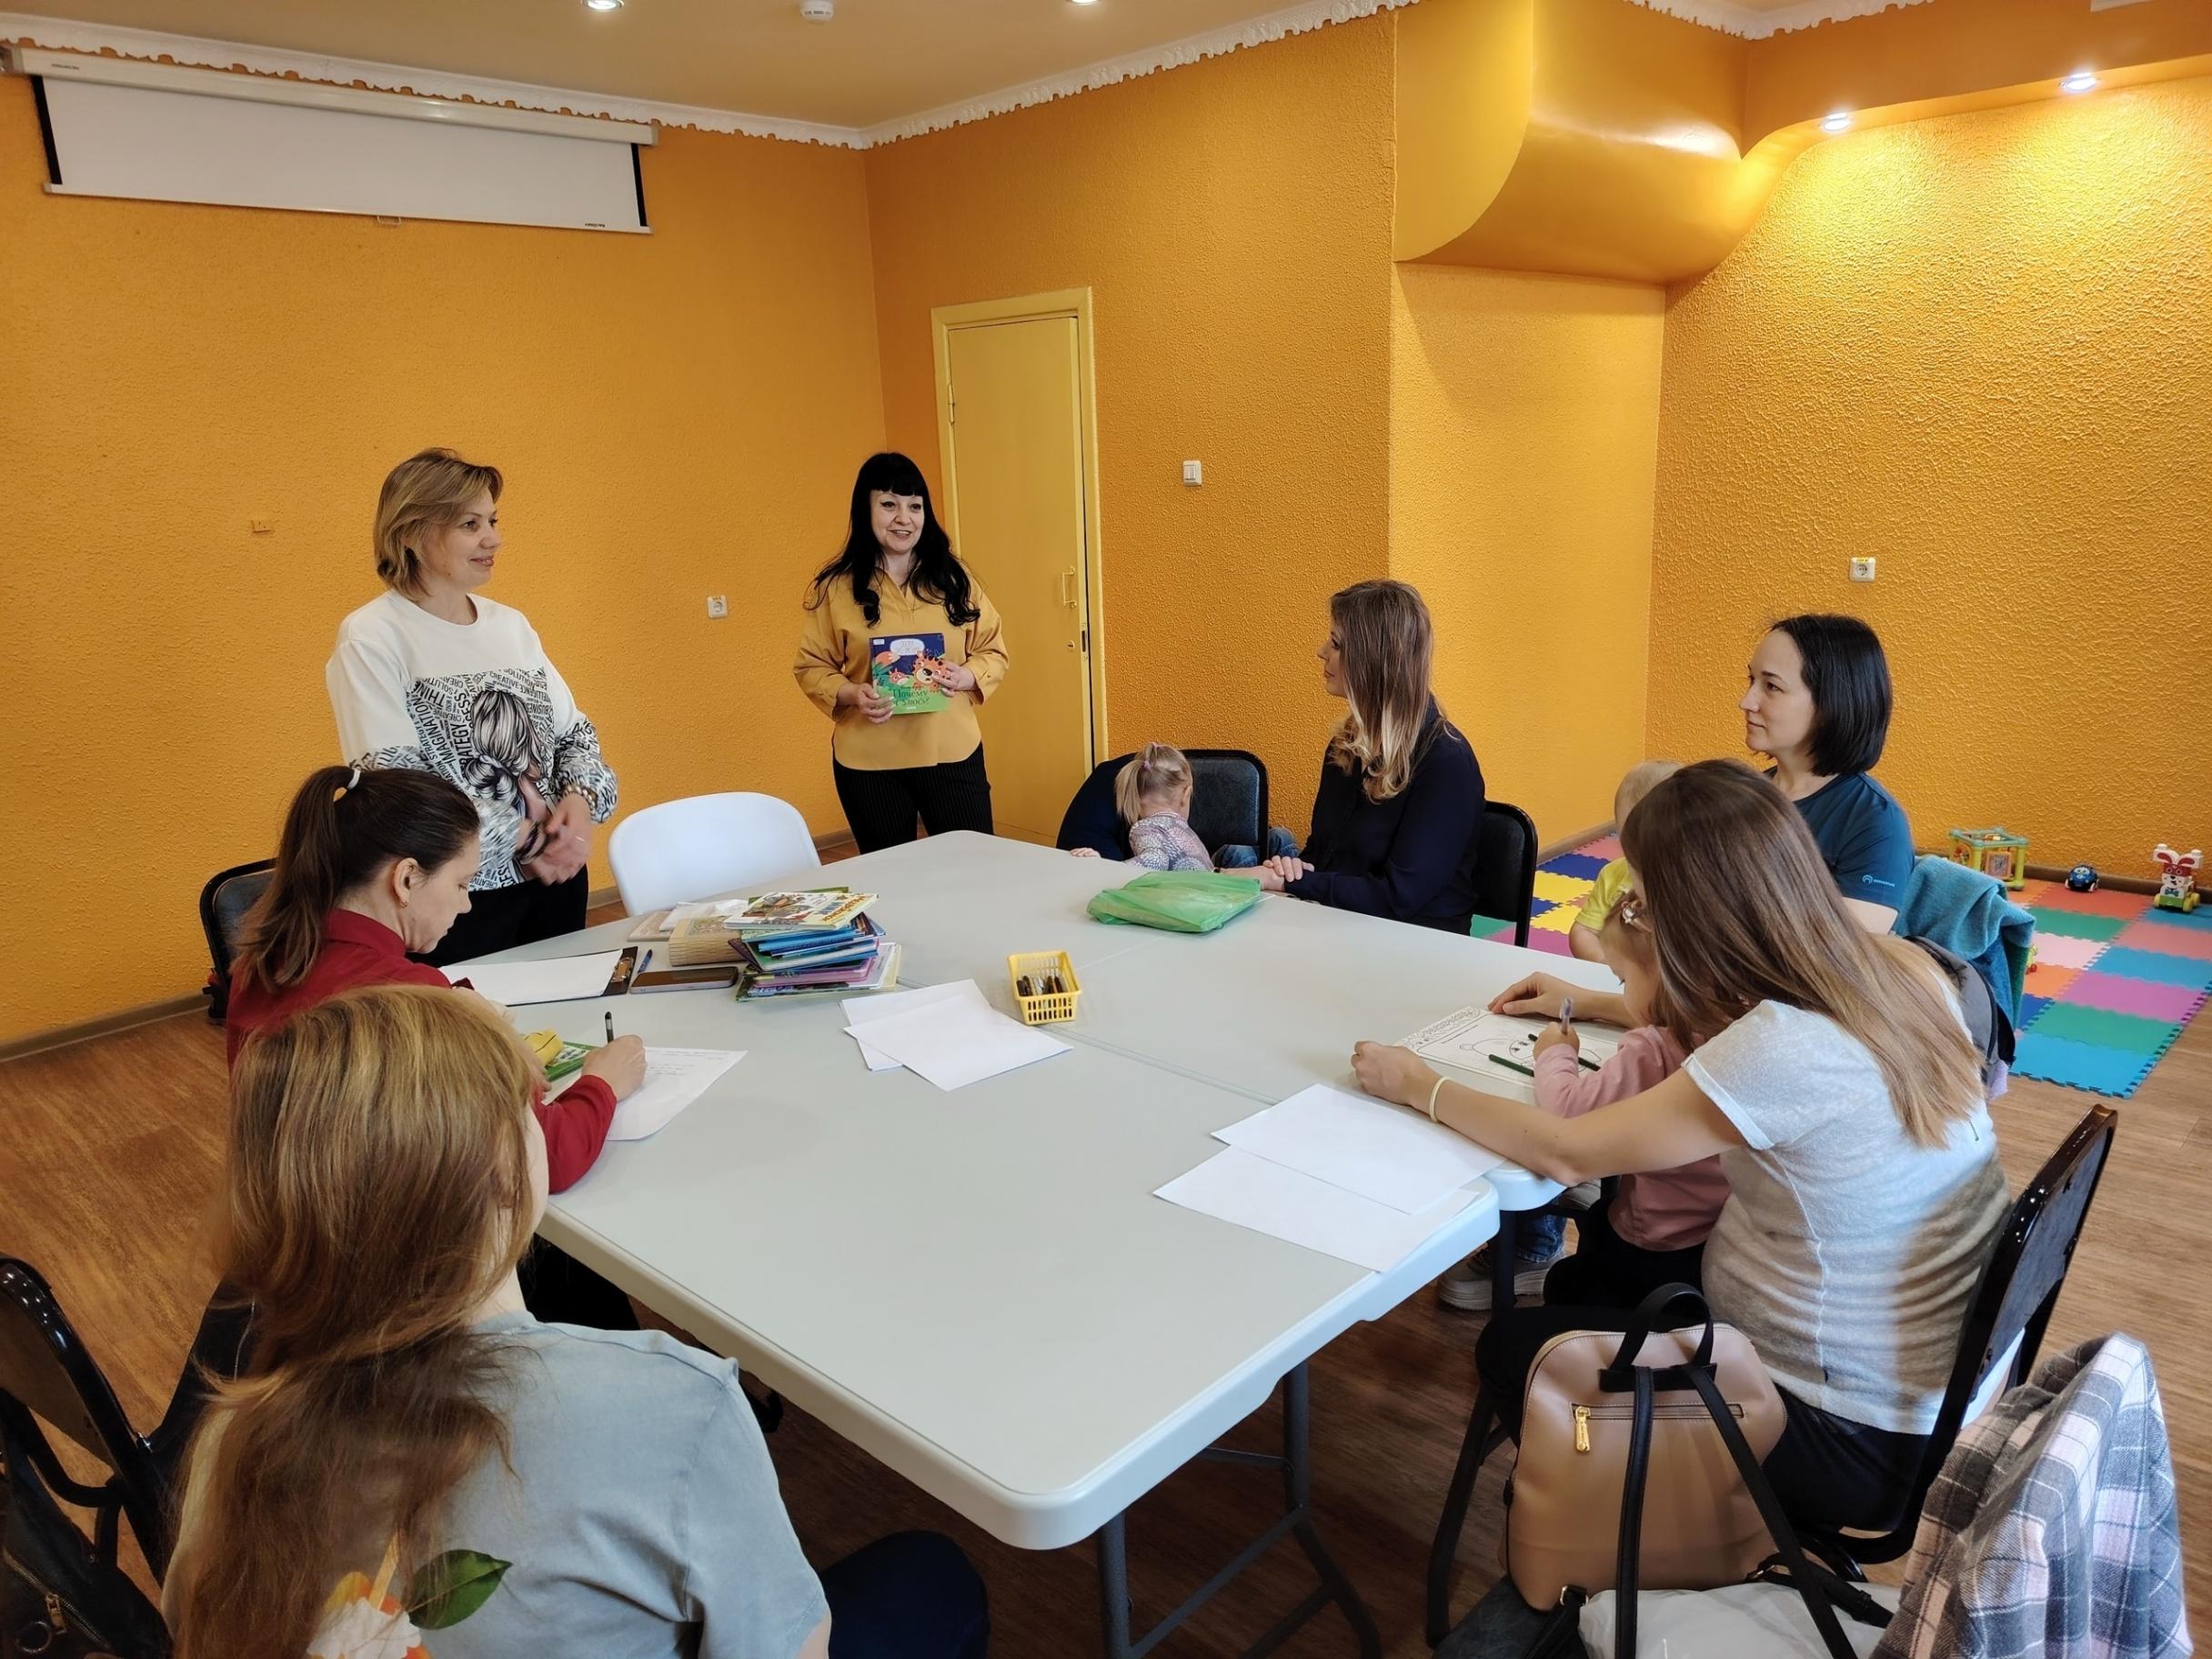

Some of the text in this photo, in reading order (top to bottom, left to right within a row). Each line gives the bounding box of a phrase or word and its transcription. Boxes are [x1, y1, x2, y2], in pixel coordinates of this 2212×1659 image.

[489, 671, 519, 689] CREATIVE
[410, 698, 457, 764] IMAGINATION
[415, 726, 438, 760] STRATEGY
